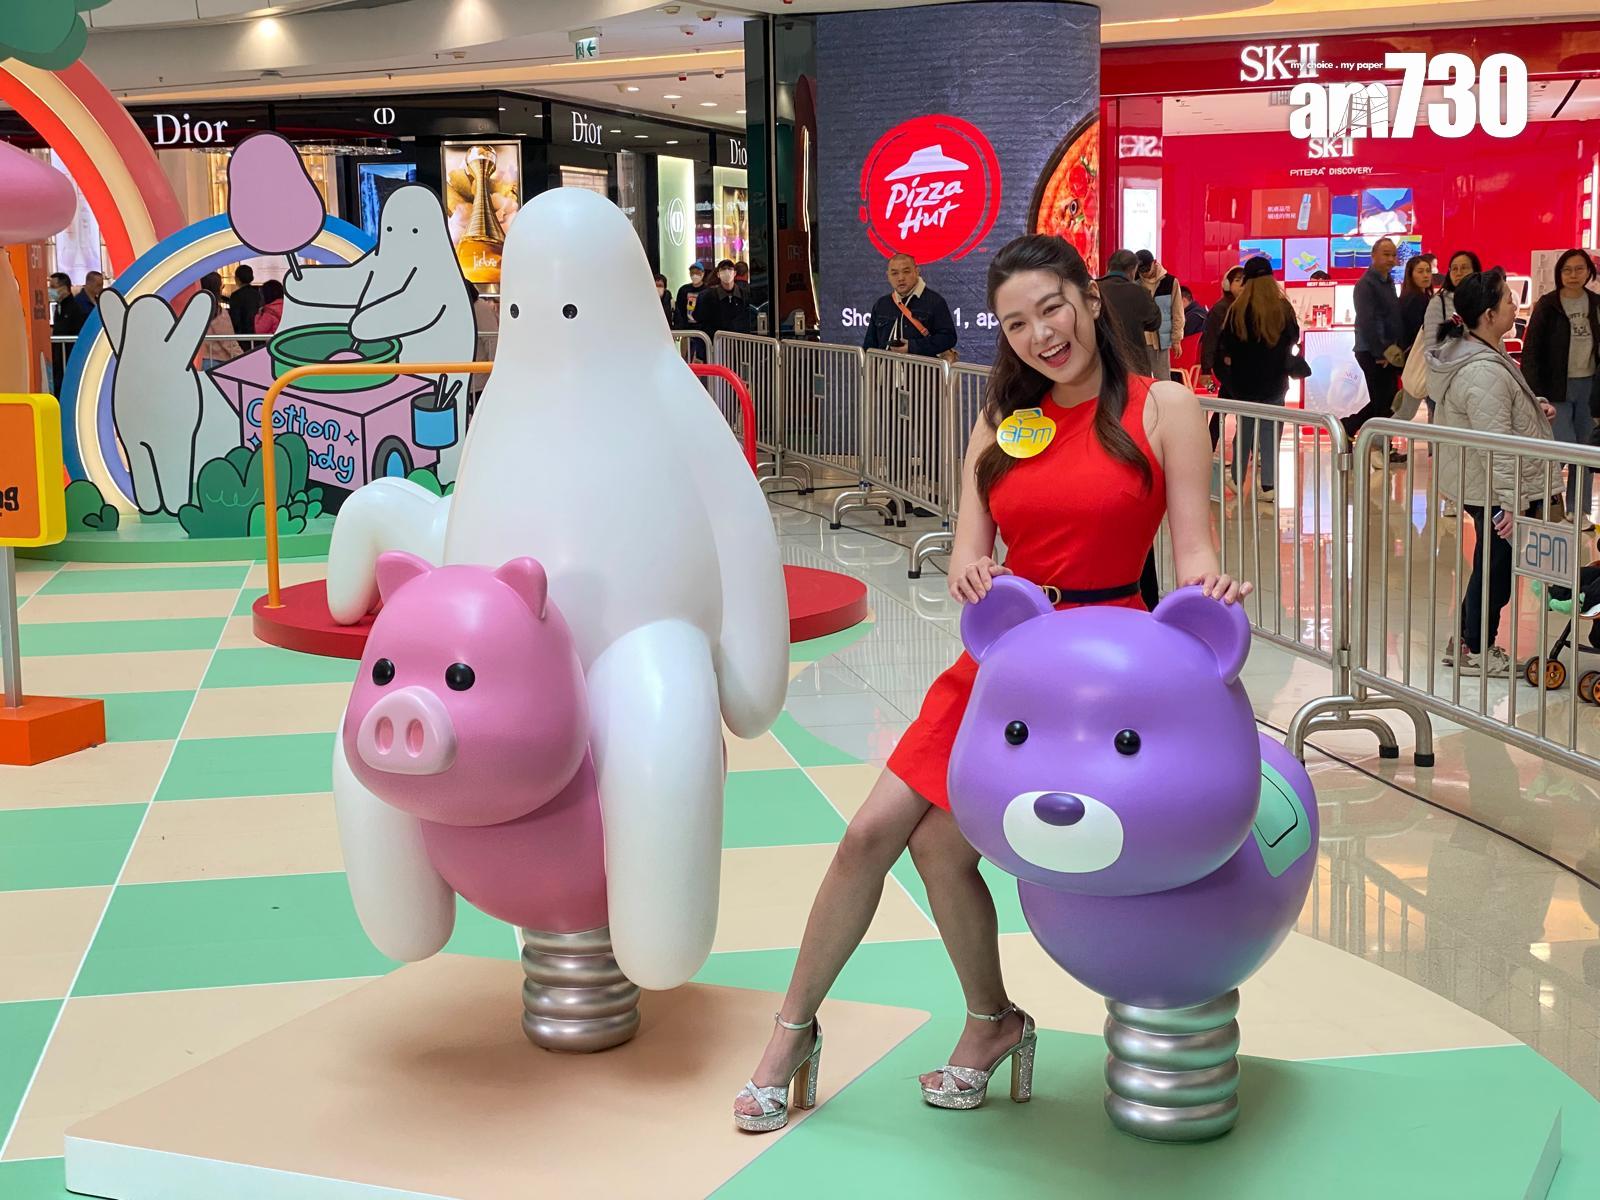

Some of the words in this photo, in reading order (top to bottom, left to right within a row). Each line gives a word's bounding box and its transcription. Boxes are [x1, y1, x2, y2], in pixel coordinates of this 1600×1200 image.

[153, 113, 228, 145] Dior
[571, 111, 602, 145] Dior
[730, 139, 747, 166] Dio
[1308, 137, 1355, 159] SK-II
[1328, 166, 1374, 176] DISCOVERY
[885, 176, 964, 219] Pizza
[897, 200, 960, 240] Hut
[841, 307, 871, 327] Sho
[976, 312, 1000, 330] ap
[246, 398, 341, 441] Cotton
[308, 443, 355, 484] ndy
